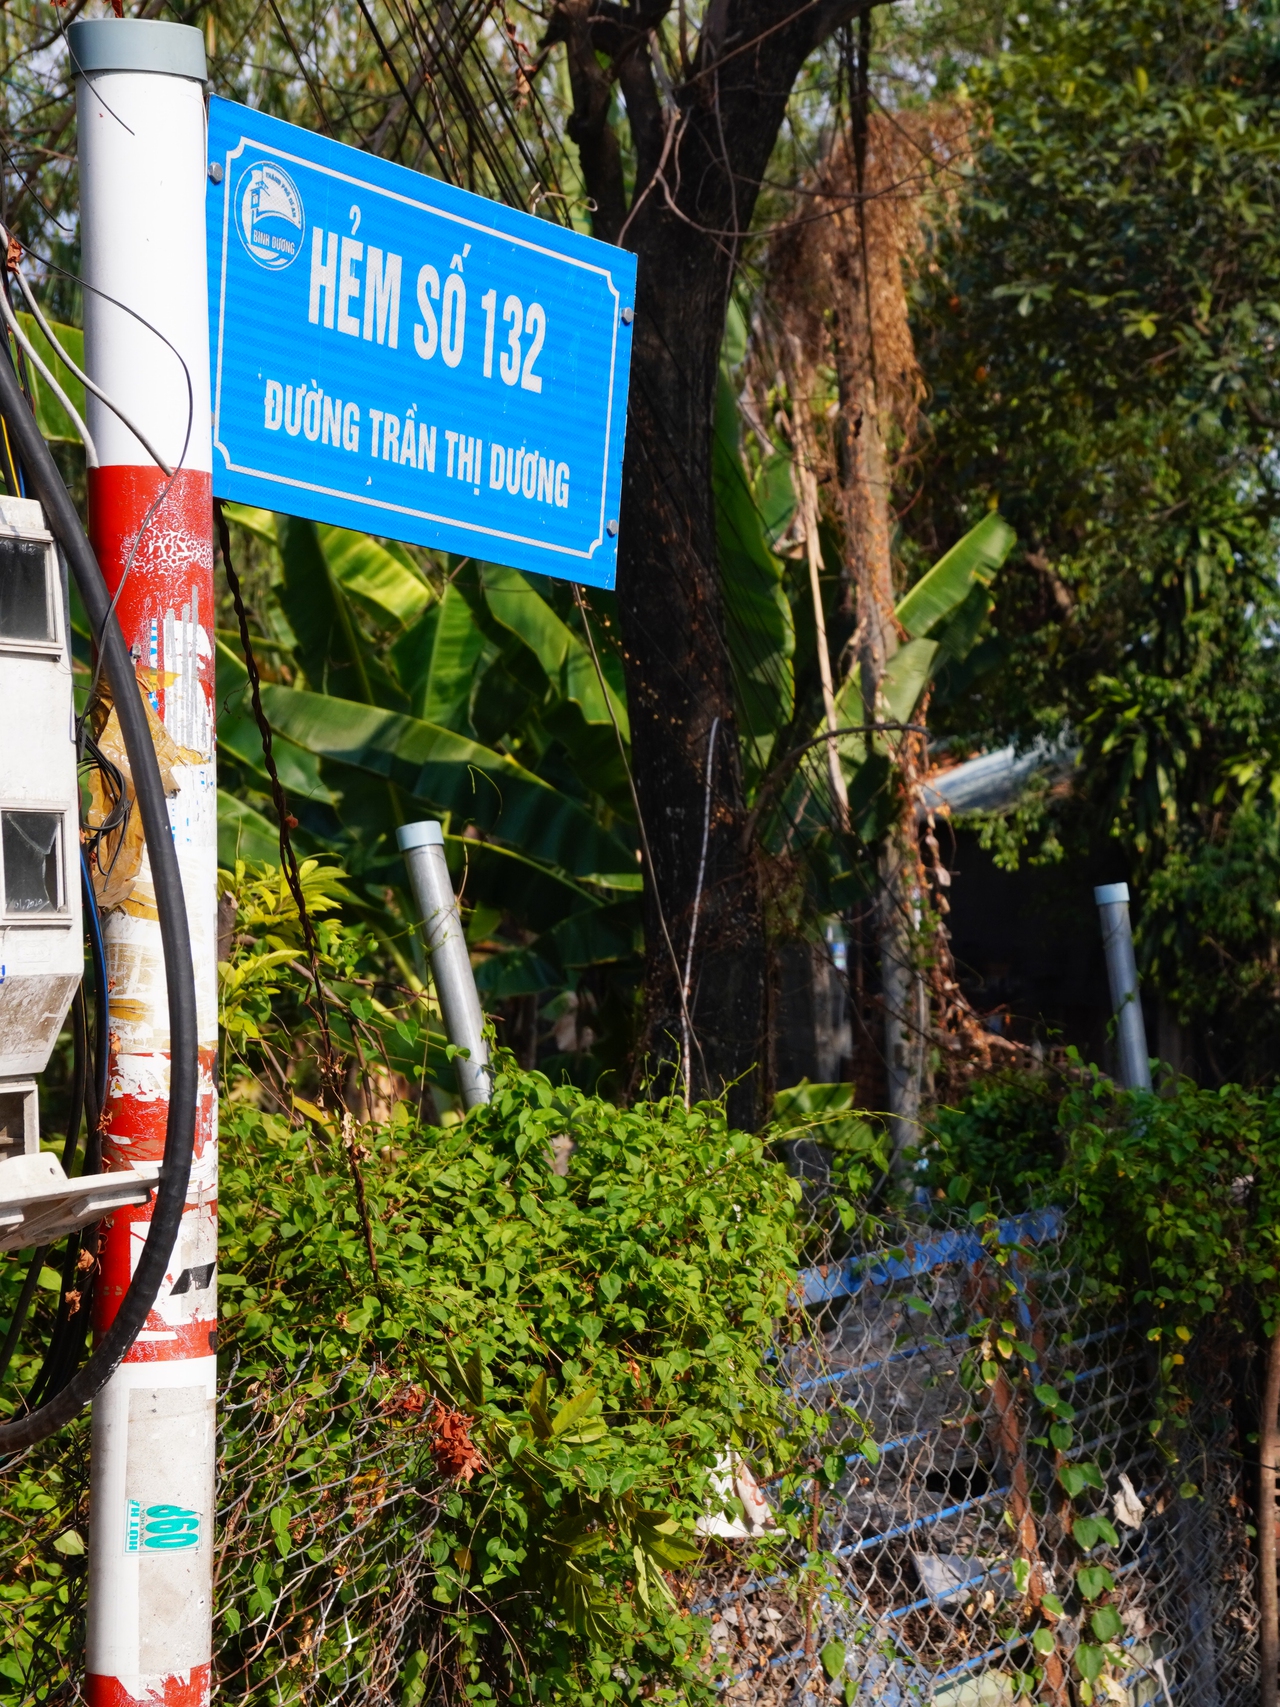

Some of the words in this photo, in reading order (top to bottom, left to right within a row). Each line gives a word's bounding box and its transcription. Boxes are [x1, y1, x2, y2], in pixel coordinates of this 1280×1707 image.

[271, 236, 296, 255] DƯƠNG
[308, 204, 403, 349] HẺM
[414, 243, 472, 369] SỐ
[480, 287, 547, 394] 132
[264, 378, 361, 453] ĐƯỜNG
[369, 403, 438, 473] TRẦN
[445, 432, 483, 497] THỊ
[489, 444, 571, 509] DƯƠNG
